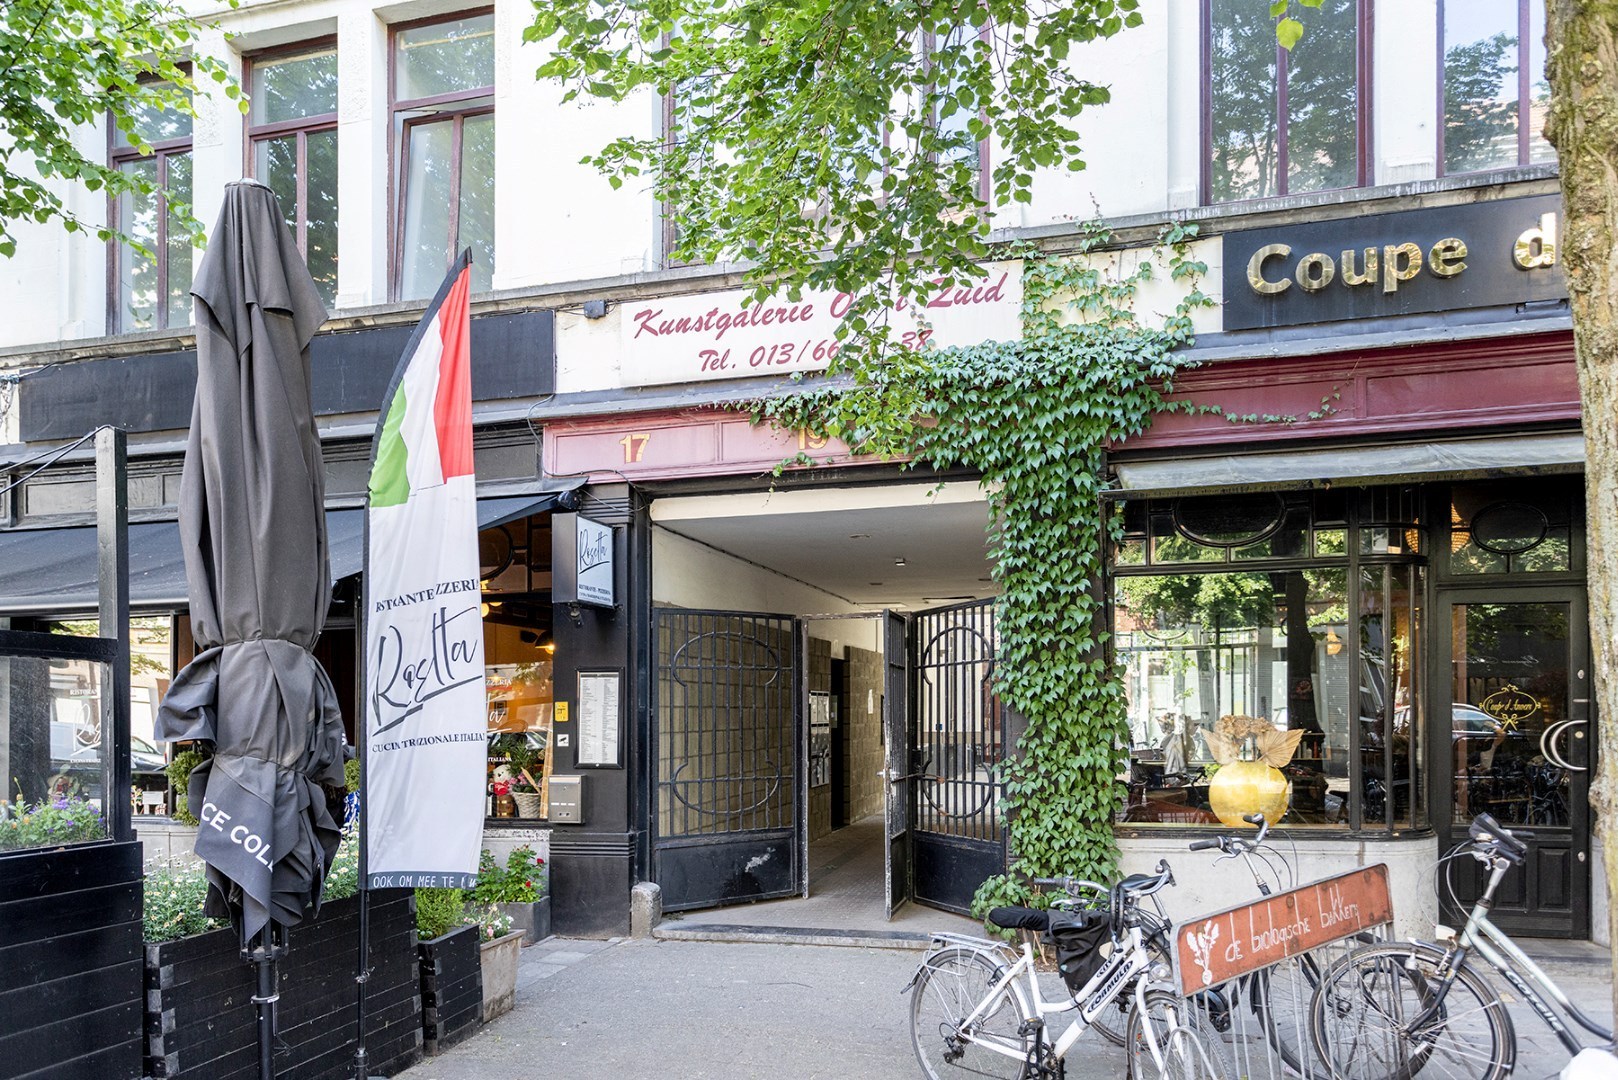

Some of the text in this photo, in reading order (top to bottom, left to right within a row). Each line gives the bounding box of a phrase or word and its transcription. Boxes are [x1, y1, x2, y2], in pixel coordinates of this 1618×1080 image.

[1247, 237, 1468, 295] Coupe
[634, 299, 814, 340] Kunstgalerie
[927, 272, 1009, 308] Zuid
[698, 348, 737, 372] Tel.
[619, 433, 651, 463] 17
[798, 426, 829, 450] 19
[202, 796, 274, 873] CE COL
[373, 876, 394, 888] OOK
[399, 875, 413, 888] OM
[417, 875, 437, 888] MEE
[442, 876, 455, 888] TE
[1089, 960, 1133, 1012] FORMULA
[1505, 970, 1564, 1032] Gazelle
